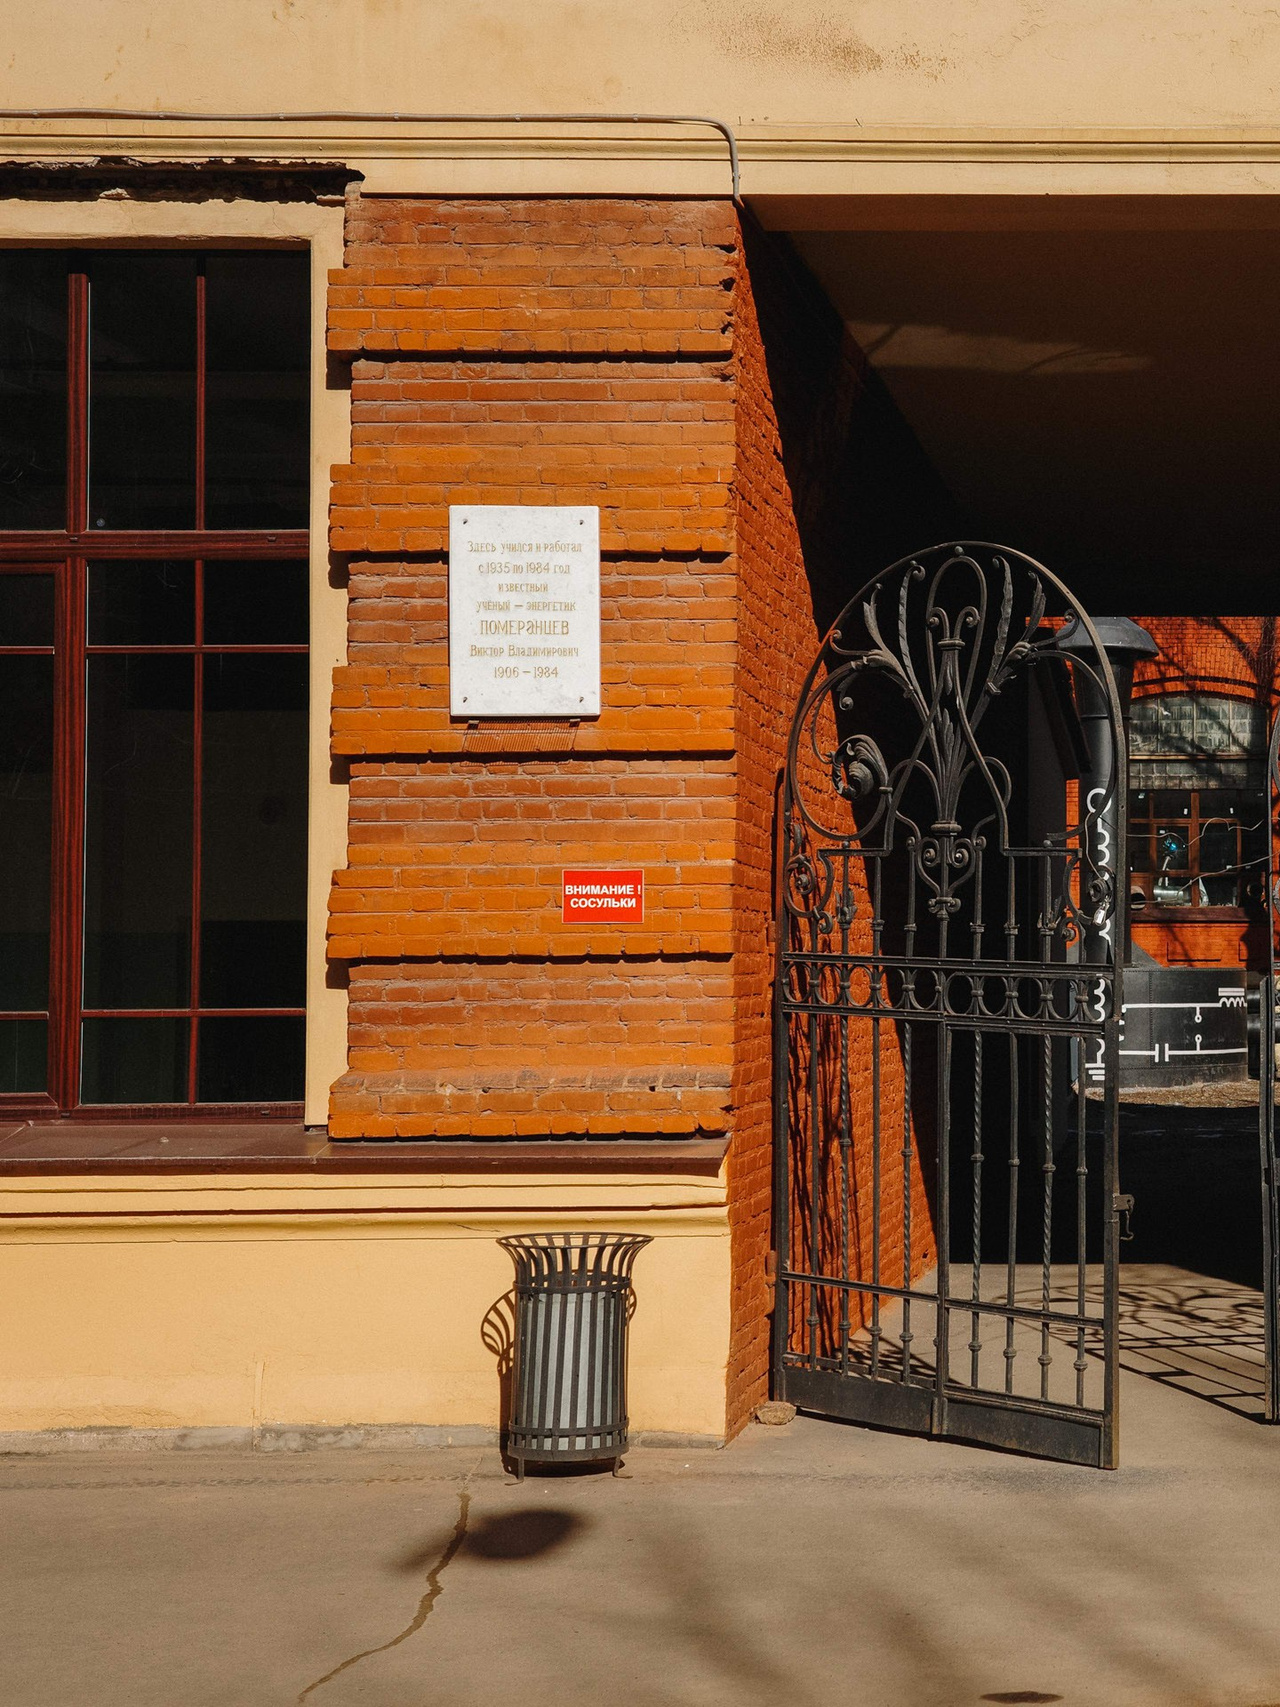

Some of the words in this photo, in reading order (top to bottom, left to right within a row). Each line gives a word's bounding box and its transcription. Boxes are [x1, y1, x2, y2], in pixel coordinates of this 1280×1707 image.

[468, 541, 496, 552] Здесь
[501, 542, 532, 554] учился
[535, 543, 541, 553] и
[544, 540, 582, 552] работал
[487, 562, 510, 574] 1935
[513, 564, 524, 574] по
[526, 562, 550, 574] 1984
[554, 564, 570, 574] год
[498, 582, 548, 592] известный
[480, 620, 569, 635] ПОМЕРАНЦЕВ
[470, 644, 504, 657] Виктор
[508, 644, 579, 657] Владимирович
[494, 666, 519, 678] 1906
[533, 666, 559, 678] 1984
[565, 884, 634, 895] ВНИМАНИЕ
[570, 898, 636, 908] СОСУЛЬКИ
